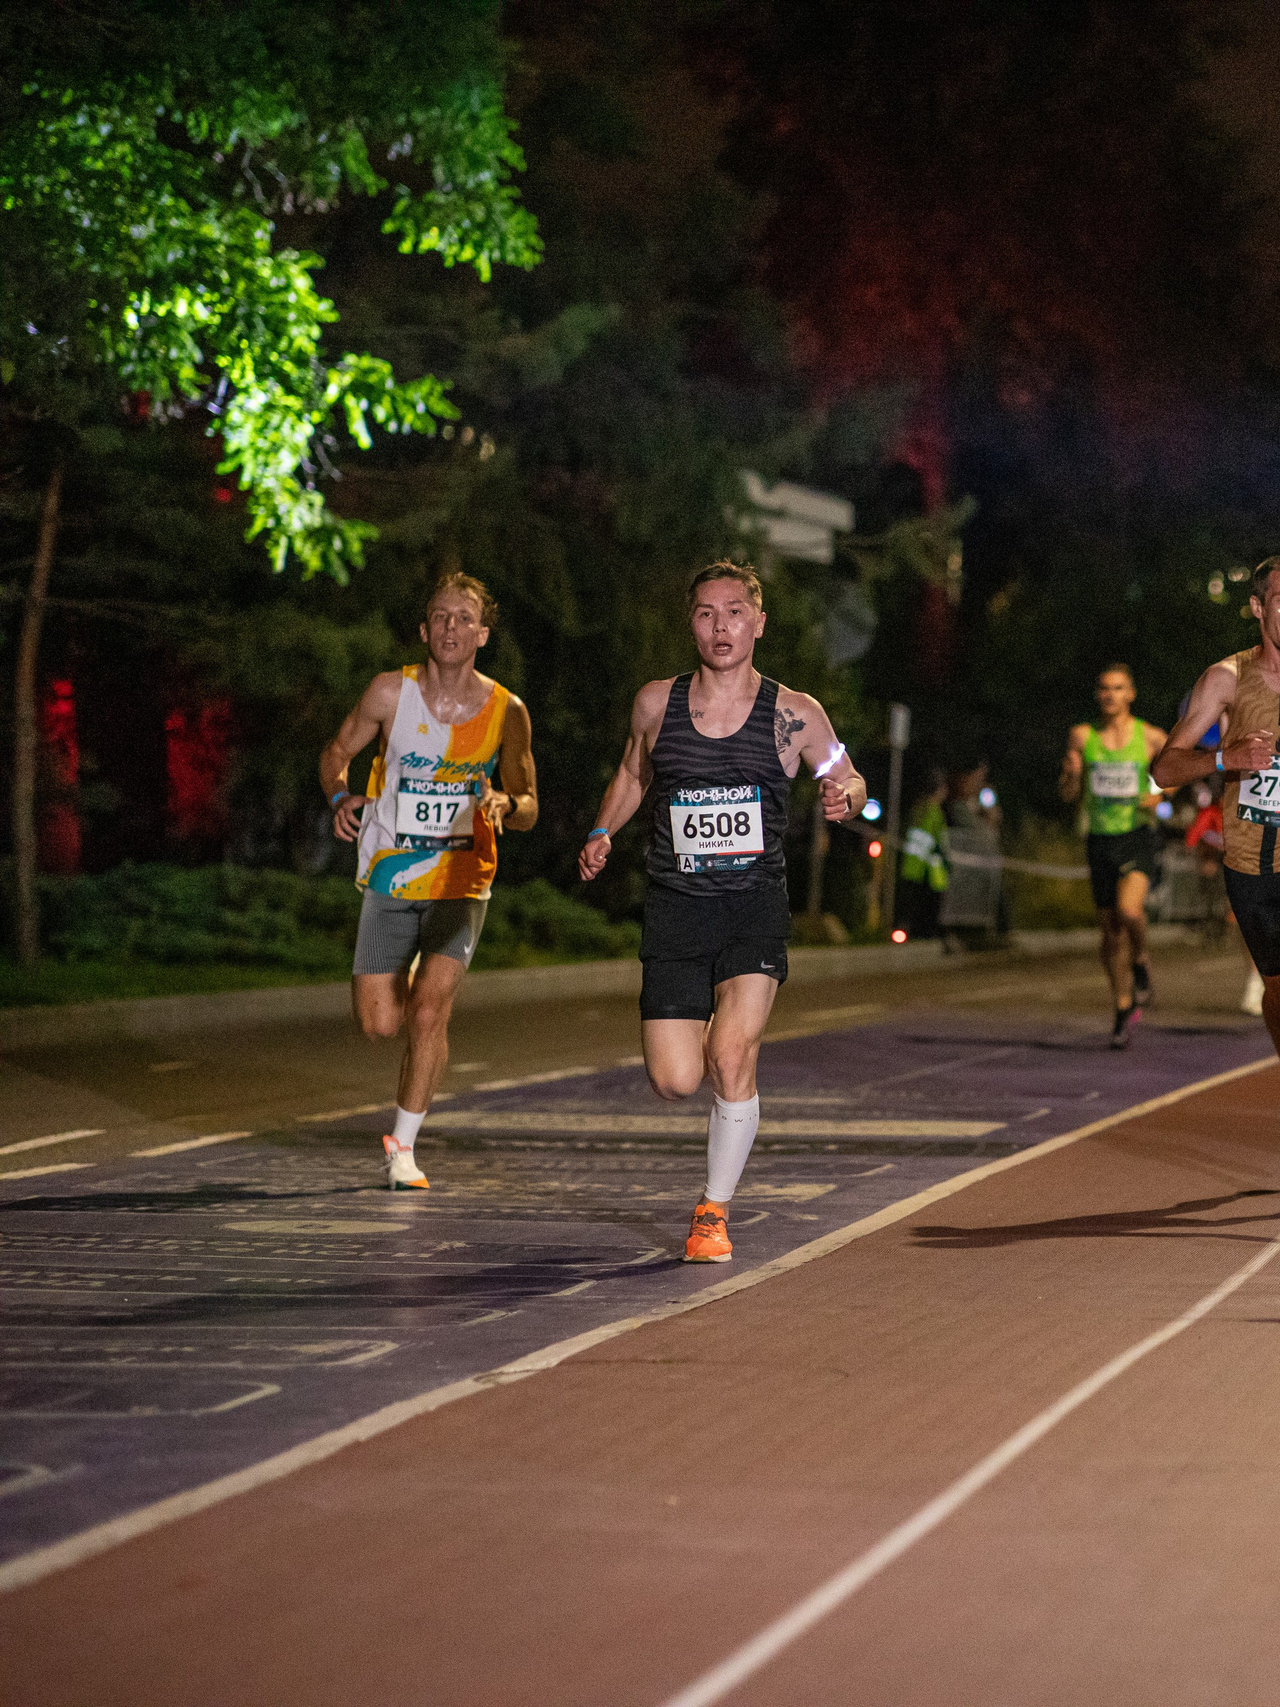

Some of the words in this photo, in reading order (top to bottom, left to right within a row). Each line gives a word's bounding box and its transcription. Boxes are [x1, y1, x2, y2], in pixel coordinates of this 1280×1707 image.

[678, 786, 753, 802] НОЧНОЙ
[415, 801, 460, 824] 817
[683, 811, 751, 839] 6508
[698, 839, 735, 849] НИКИТА
